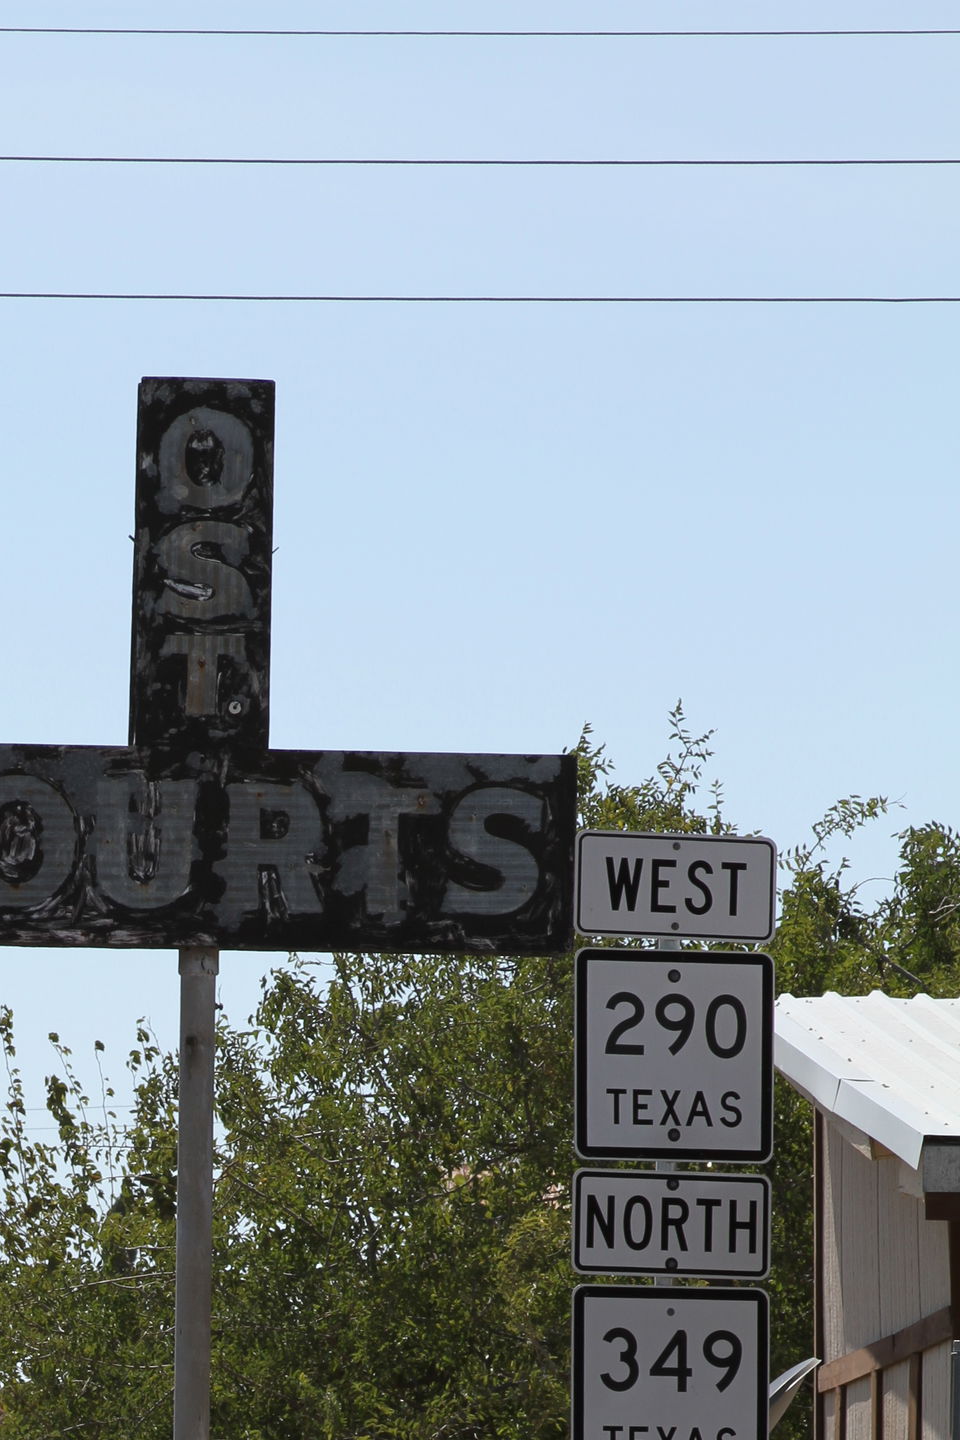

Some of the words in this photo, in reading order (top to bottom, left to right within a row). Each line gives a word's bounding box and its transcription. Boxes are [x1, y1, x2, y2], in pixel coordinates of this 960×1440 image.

[606, 857, 748, 917] WEST
[605, 992, 747, 1060] 290
[606, 1089, 743, 1128] TEXAS
[586, 1195, 758, 1254] NORTH
[600, 1328, 743, 1393] 349
